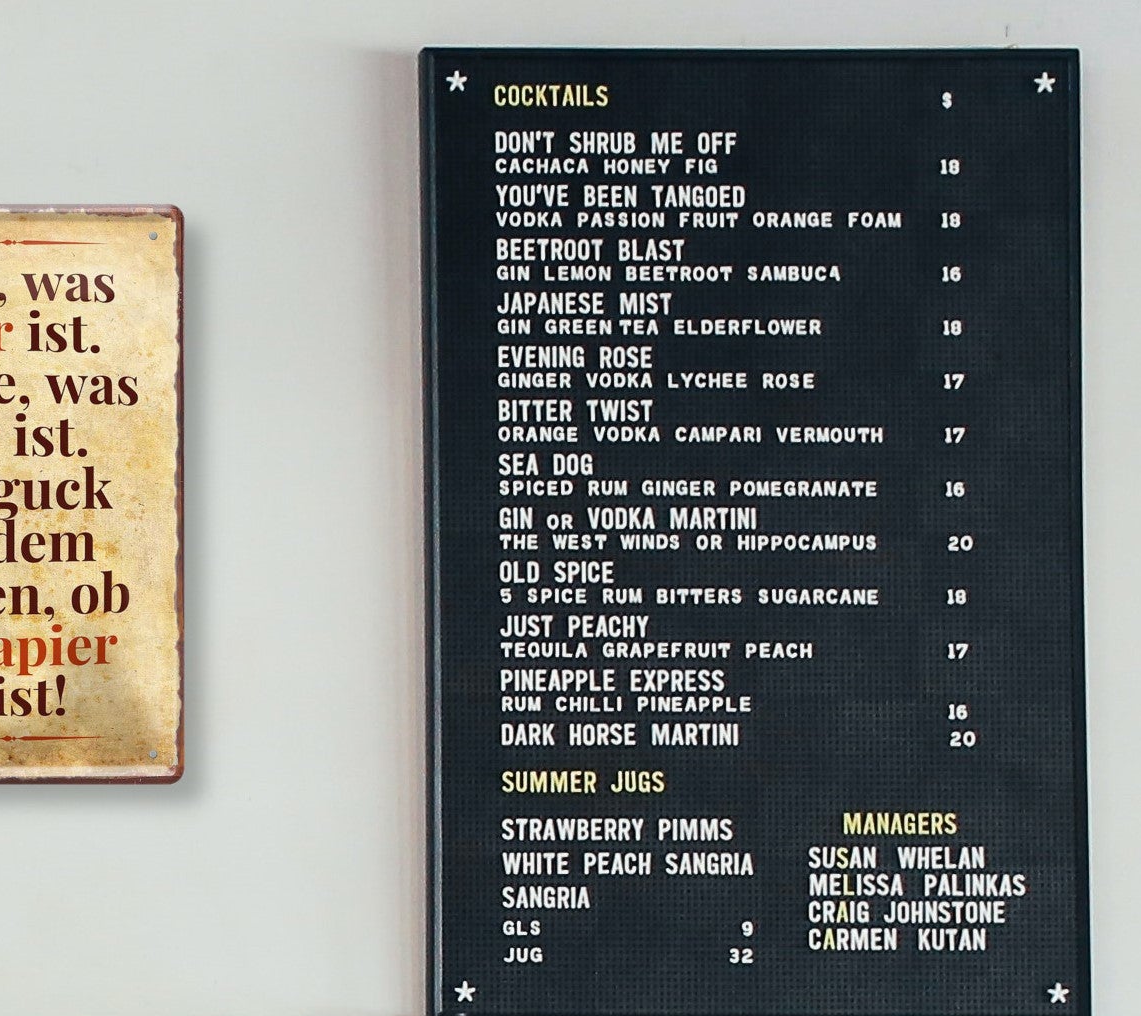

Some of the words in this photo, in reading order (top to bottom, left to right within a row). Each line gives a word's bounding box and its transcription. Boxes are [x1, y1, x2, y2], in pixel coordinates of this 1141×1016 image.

[494, 84, 609, 107] COCKTAILS
[494, 130, 555, 154] DON'T
[569, 131, 636, 155] SHRUB
[650, 131, 684, 155] ME
[697, 131, 737, 155] OFF
[495, 157, 589, 175] CACHACA
[603, 158, 671, 175] HONEY
[685, 158, 718, 175] FIG
[940, 158, 960, 176] 18
[495, 183, 569, 208] YOU'VE
[583, 184, 637, 208] BEEN
[650, 184, 746, 209] TANGOED
[495, 211, 563, 228] VODKA
[577, 211, 665, 229] PASSION
[679, 211, 739, 229] FRUIT
[752, 211, 833, 229] ORANGE
[847, 211, 902, 229] FOAM
[941, 212, 961, 229] 18
[496, 238, 604, 262] BEETROOT
[618, 238, 685, 262] BLAST
[496, 265, 530, 282] GIN
[544, 265, 612, 282] LEMON
[625, 265, 733, 282] BEETROOT
[941, 266, 962, 283] 16
[21, 273, 115, 304] was
[496, 291, 605, 315] JAPANESE
[619, 292, 672, 316] MIST
[27, 309, 101, 354] ist.
[497, 318, 531, 335] GIN
[544, 318, 613, 336] GREEN
[618, 318, 659, 336] TEA
[673, 318, 822, 336] ELDERFLOWER
[942, 319, 962, 336] 18
[497, 345, 585, 369] EVENING
[599, 345, 653, 370] ROSE
[44, 374, 139, 406] was
[497, 372, 572, 389] GINGER
[585, 372, 653, 389] VODKA
[667, 372, 748, 389] LYCHEE
[762, 372, 815, 390] ROSE
[943, 373, 965, 390] 17
[498, 399, 573, 423] BITTER
[585, 399, 653, 423] TWIST
[13, 412, 88, 458] ist.
[497, 425, 578, 443] ORANGE
[593, 425, 661, 443] VODKA
[674, 426, 762, 443] CAMPARI
[776, 426, 884, 444] VERMOUTH
[944, 427, 966, 444] 17
[498, 453, 539, 476] SEA
[552, 453, 594, 476] DOG
[499, 479, 574, 497] SPICED
[587, 479, 628, 497] RUM
[641, 479, 716, 497] GINGER
[729, 480, 878, 498] POMEGRANATE
[945, 480, 965, 498] 16
[499, 506, 533, 530] GIN
[546, 513, 574, 531] OR
[586, 506, 656, 530] VODKA
[669, 506, 757, 531] MARTINI
[499, 533, 539, 551] THE
[552, 533, 608, 551] WEST
[619, 533, 680, 551] WINDS
[695, 534, 723, 551] OR
[737, 534, 877, 552] HIPPOCAMPUS
[947, 535, 974, 552] 20
[499, 560, 540, 584] OLD
[553, 560, 615, 584] SPICE
[71, 570, 130, 615] ob
[499, 587, 512, 604] 5
[527, 587, 587, 605] SPICE
[602, 587, 643, 605] RUM
[656, 587, 743, 605] BITTERS
[758, 588, 879, 606] SUGARCANE
[947, 588, 967, 605] 18
[499, 614, 554, 638] JUST
[567, 614, 649, 639] PEACHY
[500, 641, 588, 659] TEQUILA
[602, 641, 731, 659] GRAPEFRUIT
[745, 642, 813, 659] PEACH
[947, 643, 969, 660] 17
[500, 668, 616, 693] PINEAPPLE
[630, 669, 725, 693] EXPRESS
[501, 695, 542, 712] RUM
[555, 695, 623, 713] CHILLI
[637, 695, 752, 713] PINEAPPLE
[947, 703, 968, 721] 16
[501, 722, 555, 747] DARK
[569, 722, 637, 747] HORSE
[651, 722, 739, 747] MARTINI
[949, 730, 977, 748] 20
[501, 770, 597, 794] SUMMER
[610, 770, 665, 793] JUGS
[501, 817, 644, 842] STRAWBERRY
[658, 817, 734, 842] PIMMS
[843, 812, 958, 836] MANAGERS
[502, 851, 570, 876] WHITE
[583, 851, 652, 876] PEACH
[664, 852, 754, 876] SANGRIA
[808, 845, 877, 870] SUSAN
[897, 846, 985, 870] WHELAN
[809, 873, 904, 897] MELISSA
[924, 873, 1027, 898] PALINKAS
[502, 885, 591, 910] SANGRIA
[808, 900, 870, 924] CRAIG
[883, 900, 1006, 925] JOHNSTONE
[502, 920, 541, 936] GLS
[741, 920, 754, 937] 9
[808, 927, 898, 951] CARMEN
[917, 927, 987, 952] KUTAN
[503, 946, 543, 963] JUG
[729, 947, 754, 964] 32
